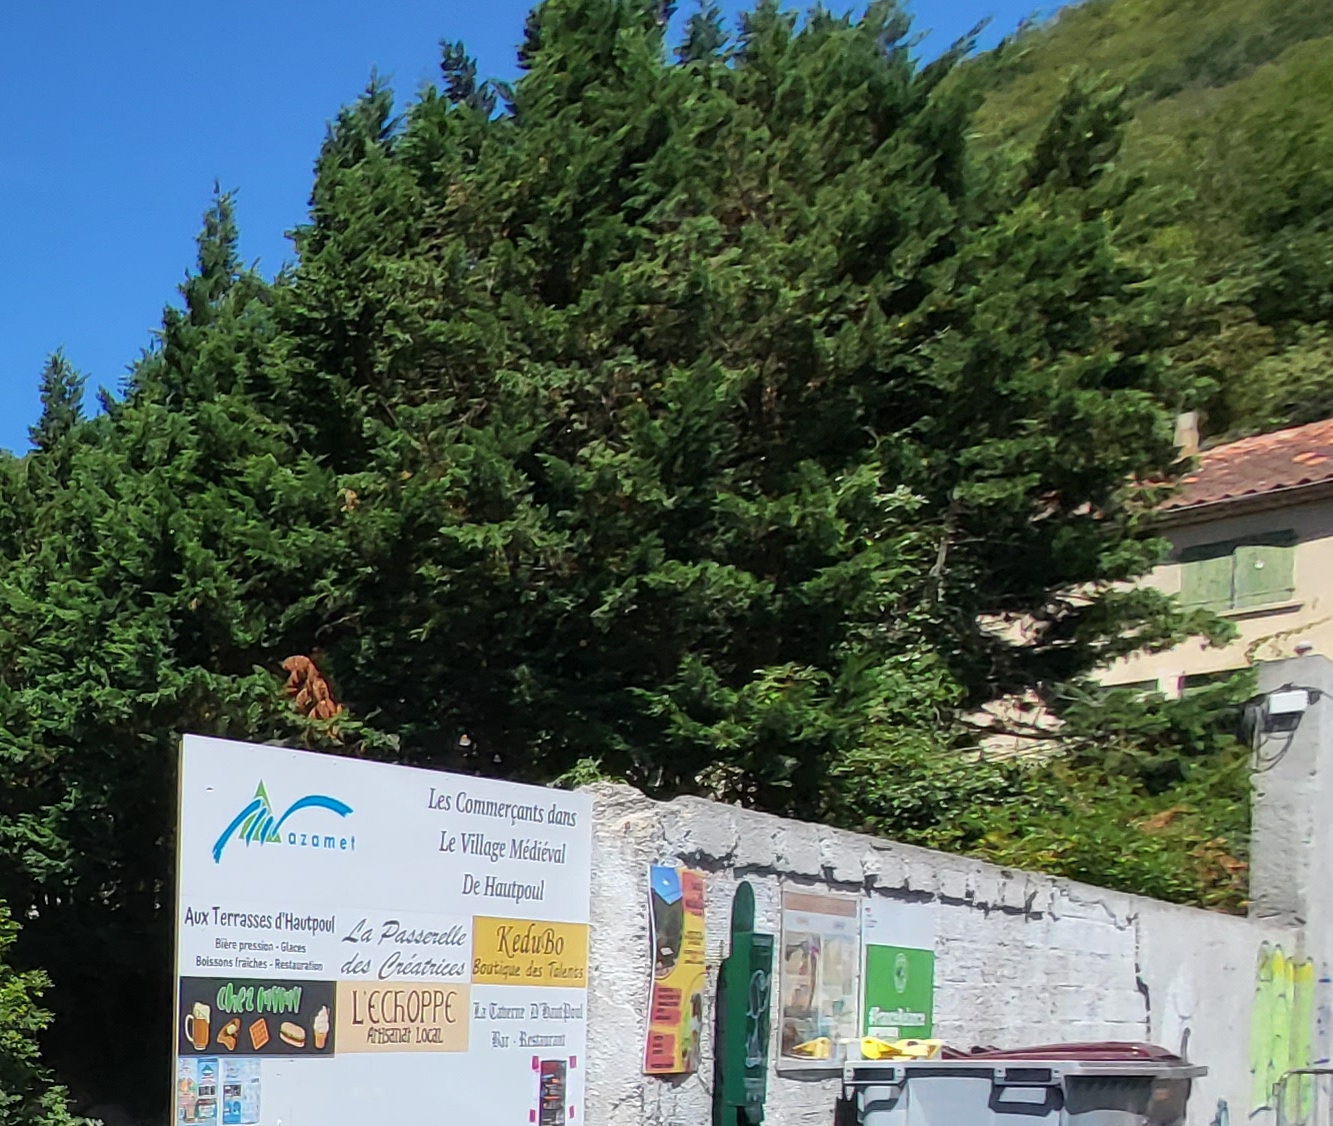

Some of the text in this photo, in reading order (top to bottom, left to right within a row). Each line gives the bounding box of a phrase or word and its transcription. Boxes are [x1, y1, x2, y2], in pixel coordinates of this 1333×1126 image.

[428, 787, 578, 827] Les Commerçants dans
[439, 831, 566, 864] Le Village Médiéval
[462, 874, 545, 904] De Hautpoul
[184, 906, 335, 936] Aux Terrasses d'Hautpoul
[342, 918, 467, 947] La Passerelle
[215, 938, 306, 953] Bière pression Glaces
[196, 956, 323, 971] Boissons fraîches Restauration
[340, 950, 466, 980] des Créatrices
[472, 958, 520, 980] Boutique
[525, 959, 542, 978] des
